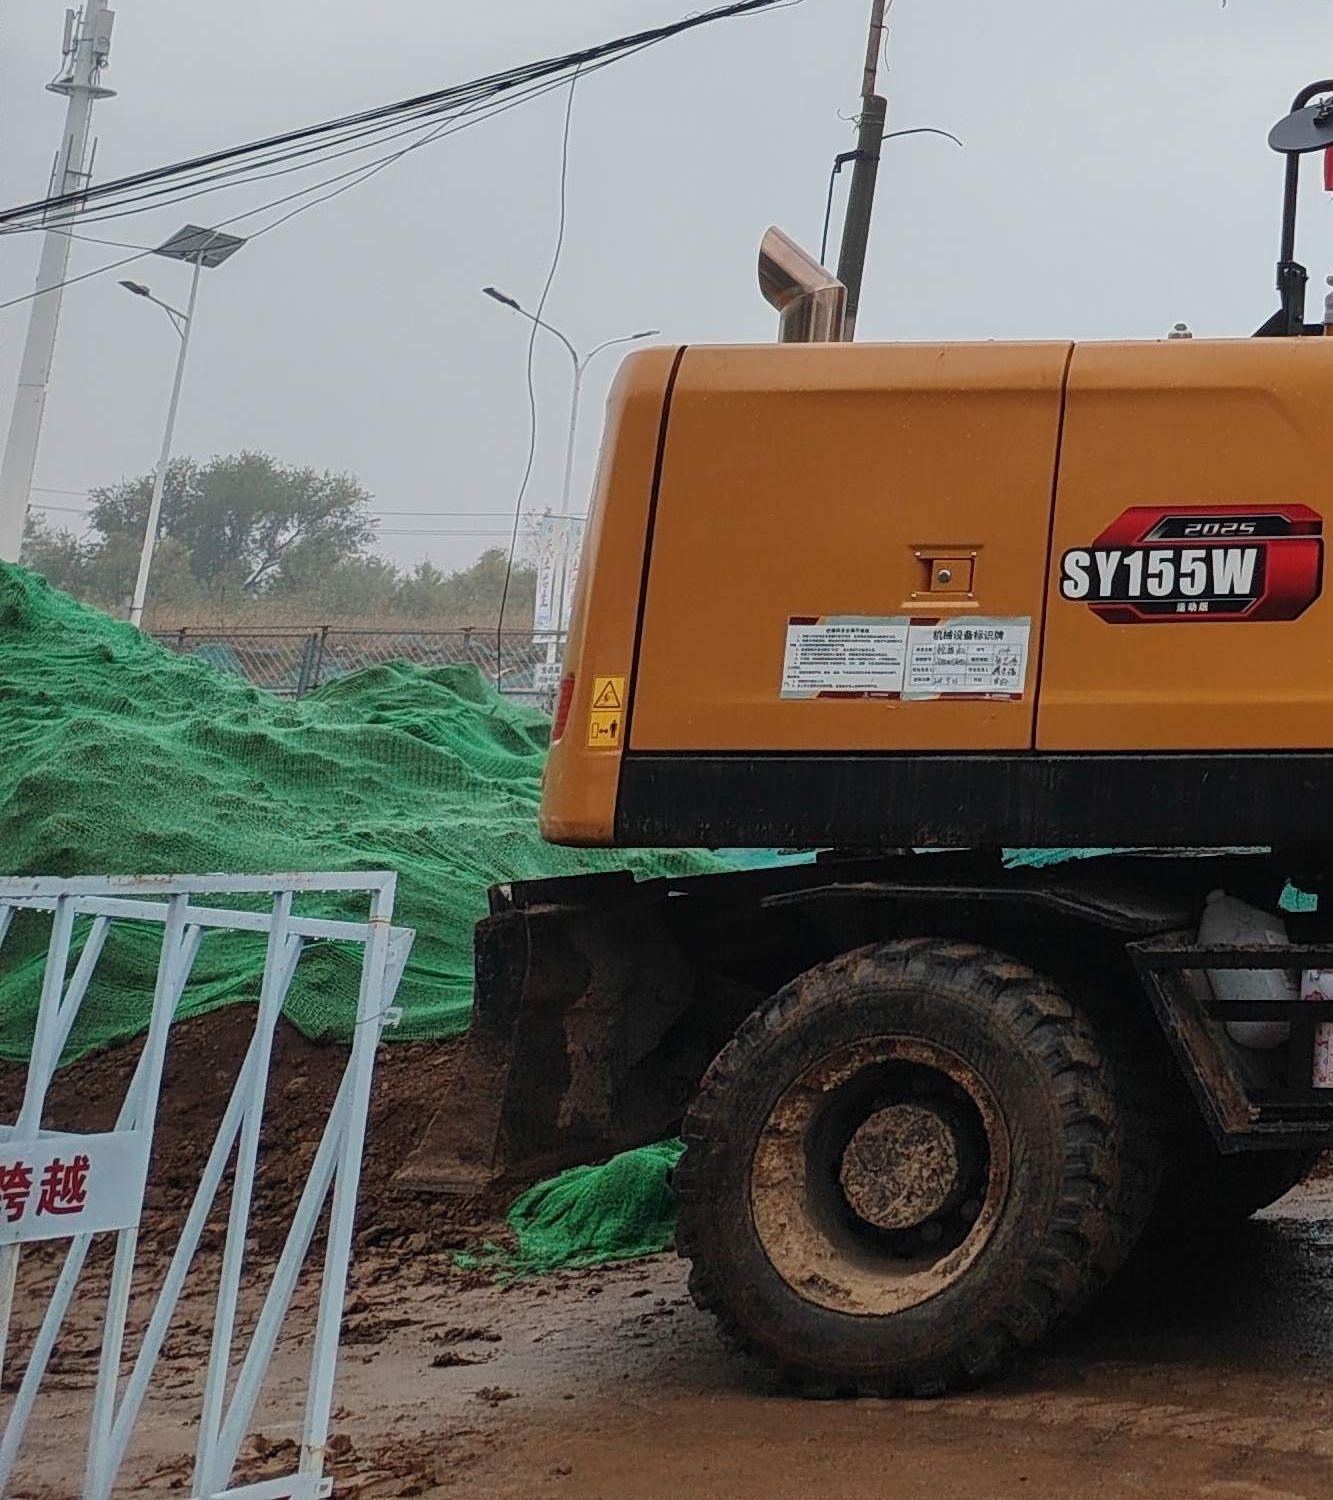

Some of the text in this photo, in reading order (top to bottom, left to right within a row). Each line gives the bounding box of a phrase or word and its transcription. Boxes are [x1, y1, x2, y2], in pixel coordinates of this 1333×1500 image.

[1184, 522, 1256, 536] 2025
[1063, 548, 1258, 599] SY155W
[933, 629, 1005, 641] 机械设备标识牌
